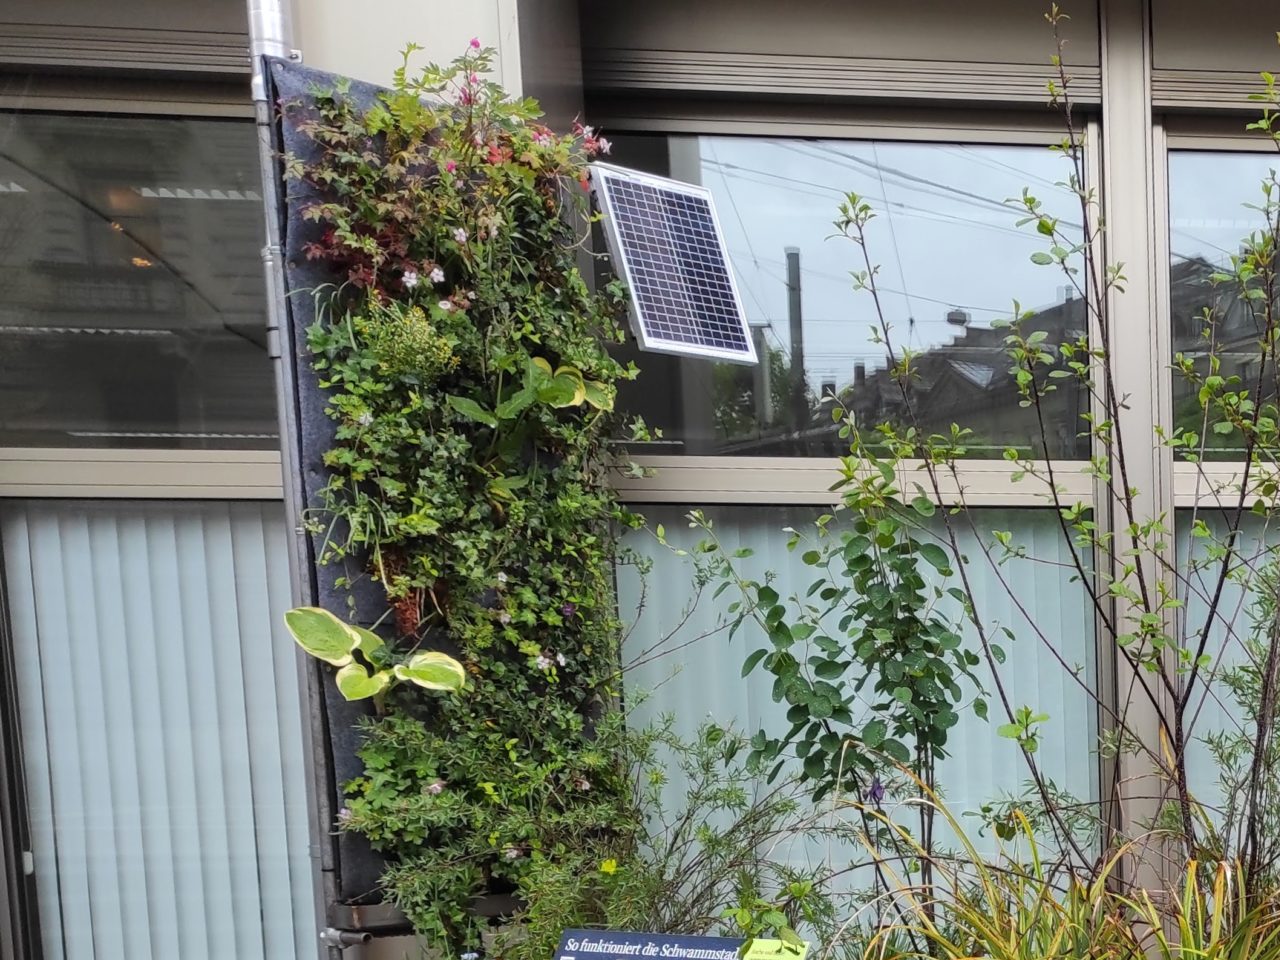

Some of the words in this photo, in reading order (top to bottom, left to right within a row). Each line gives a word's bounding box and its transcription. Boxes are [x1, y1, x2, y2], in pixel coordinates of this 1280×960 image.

[565, 938, 579, 951] So
[579, 938, 640, 955] funktioniert
[642, 942, 658, 956] die
[660, 943, 740, 960] Schwammstad
